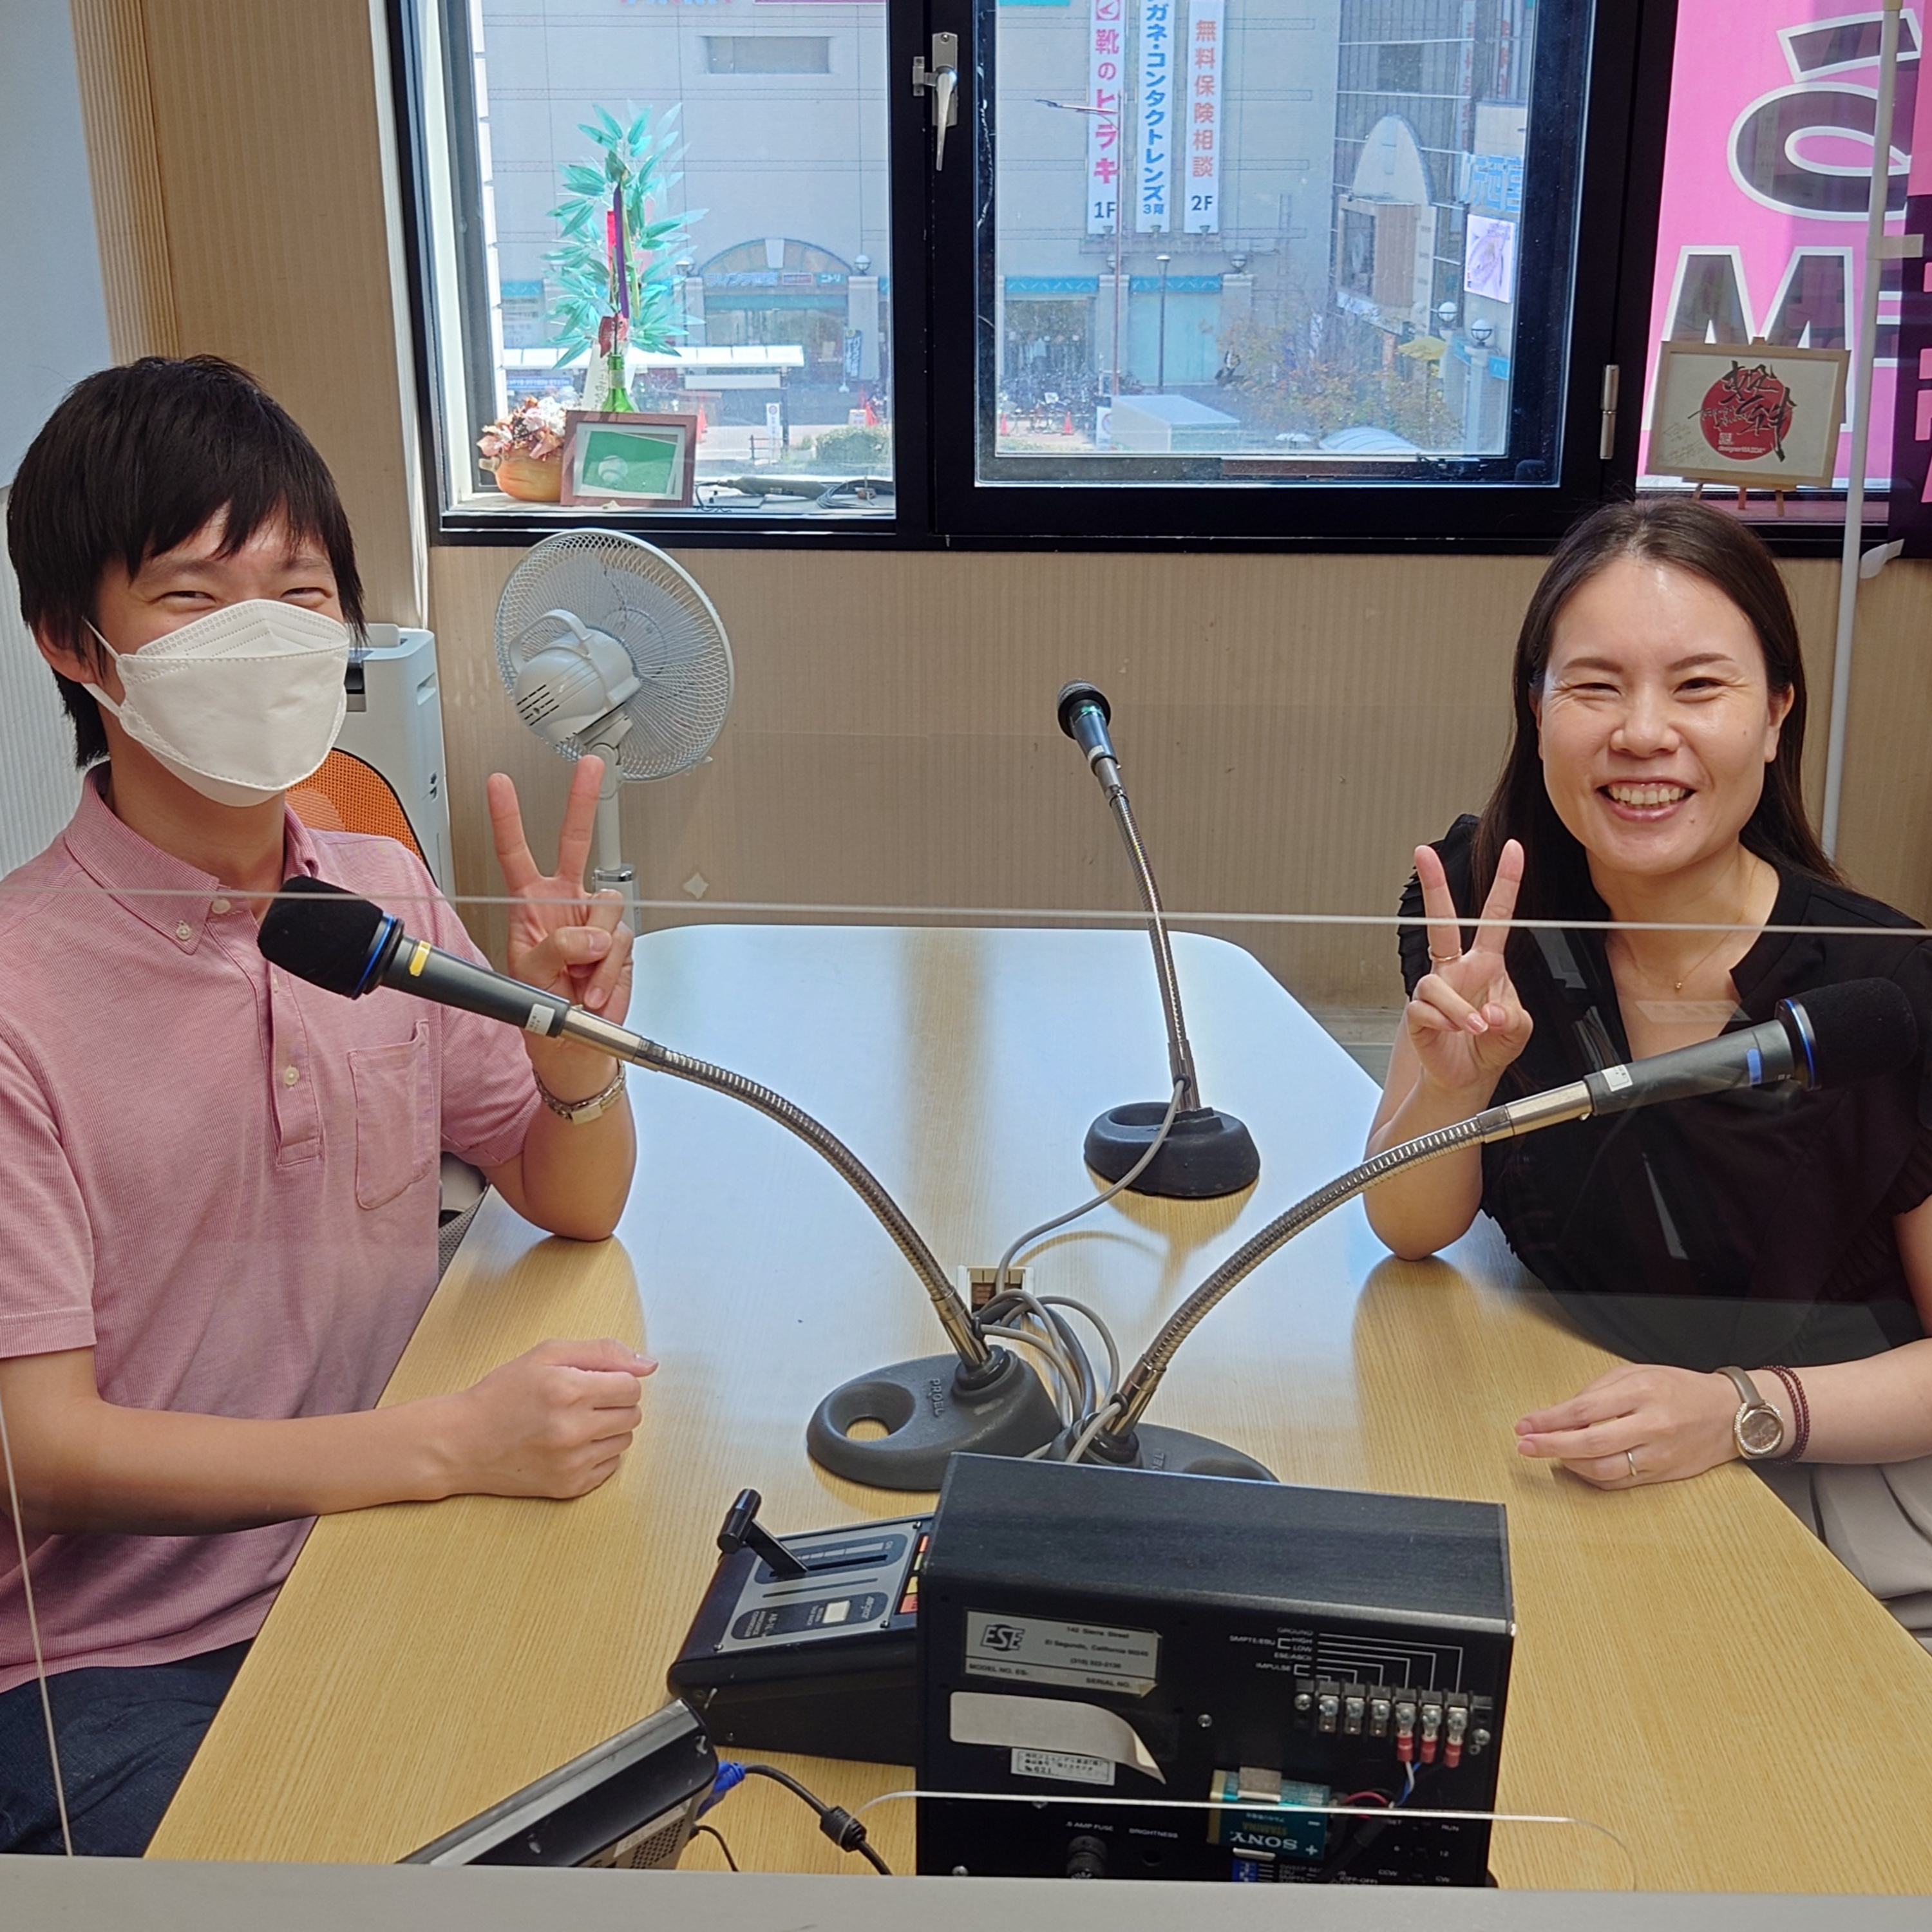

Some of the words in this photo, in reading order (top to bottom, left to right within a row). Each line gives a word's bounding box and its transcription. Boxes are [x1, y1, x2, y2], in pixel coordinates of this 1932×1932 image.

[1143, 0, 1169, 201] ガネ・コンタクトレンズ
[1192, 20, 1217, 178] 無料保険相談
[1094, 202, 1115, 218] 1F
[1191, 195, 1213, 211] 2F
[929, 1377, 945, 1416] PROEL
[980, 1624, 1025, 1651] ESE
[969, 1663, 998, 1672] MODEL
[1086, 1677, 1115, 1687] SERIAL
[1094, 1824, 1114, 1832] FUSE
[1128, 1828, 1179, 1839] BRIGHTNESS
[1231, 1832, 1298, 1851] SONY
